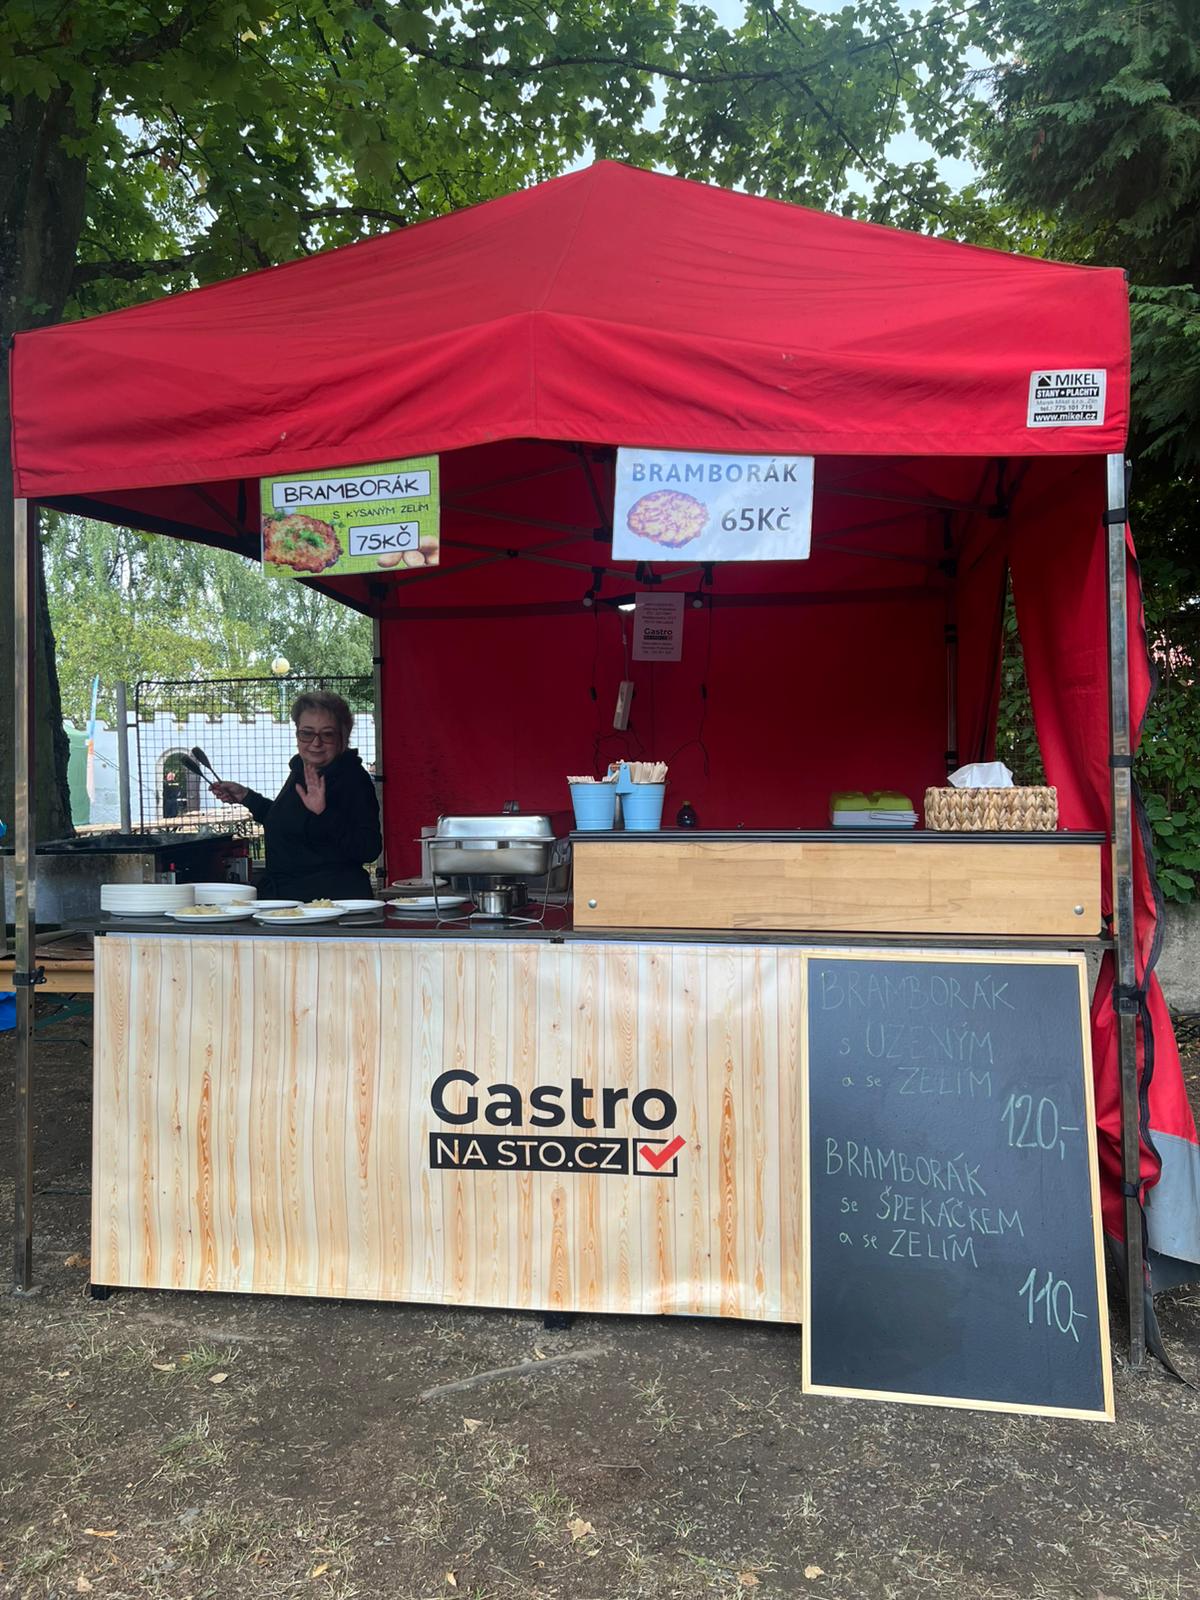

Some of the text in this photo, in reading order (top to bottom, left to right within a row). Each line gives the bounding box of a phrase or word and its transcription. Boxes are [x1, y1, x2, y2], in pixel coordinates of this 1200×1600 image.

[1036, 388, 1098, 398] STANY PLACHTY
[1055, 373, 1098, 386] MIKEL
[1035, 412, 1097, 421] www.mikel.cz
[632, 458, 798, 483] BRAMBORÁK
[284, 475, 419, 503] BRAMBORÁK
[332, 510, 340, 519] S
[346, 505, 395, 518] KYSANÝM
[721, 506, 791, 532] 65Kč
[356, 525, 412, 551] 75KČ
[643, 627, 673, 635] Gastro
[821, 969, 1015, 1011] BRAMBORÁK
[865, 1022, 994, 1064] UZENÝM
[841, 1066, 992, 1097] a se ZELÍM
[430, 1068, 677, 1131] Gastro
[436, 1137, 622, 1169] NA STO.CZ
[826, 1137, 986, 1197] BRAMBORÁK
[840, 1185, 1024, 1237] se ŠPEKÁČKEM
[839, 1229, 978, 1268] a se ZELÍM
